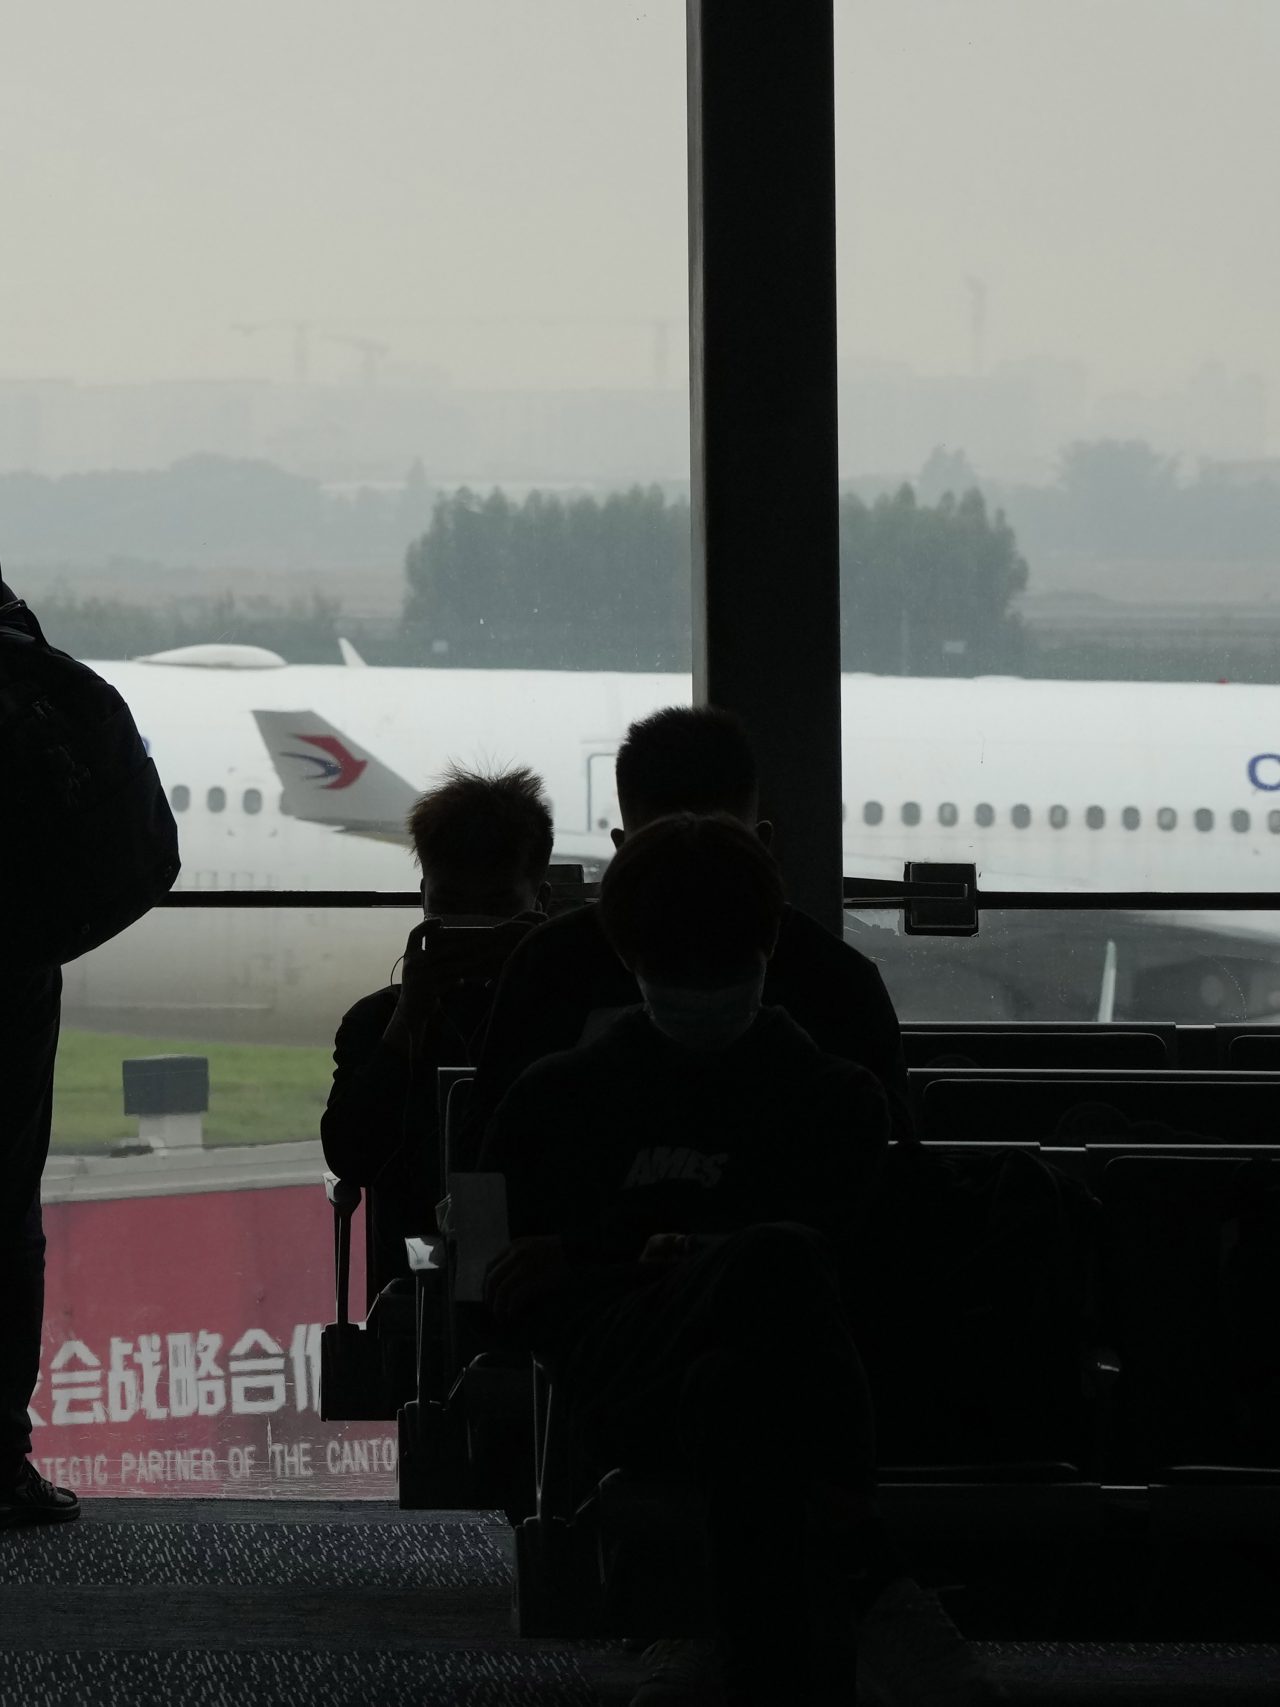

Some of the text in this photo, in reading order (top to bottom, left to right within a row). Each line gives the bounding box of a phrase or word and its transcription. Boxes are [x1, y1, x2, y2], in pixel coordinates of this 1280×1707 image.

[32, 1437, 398, 1486] TEGIC PARTNER OF THE CANTO
